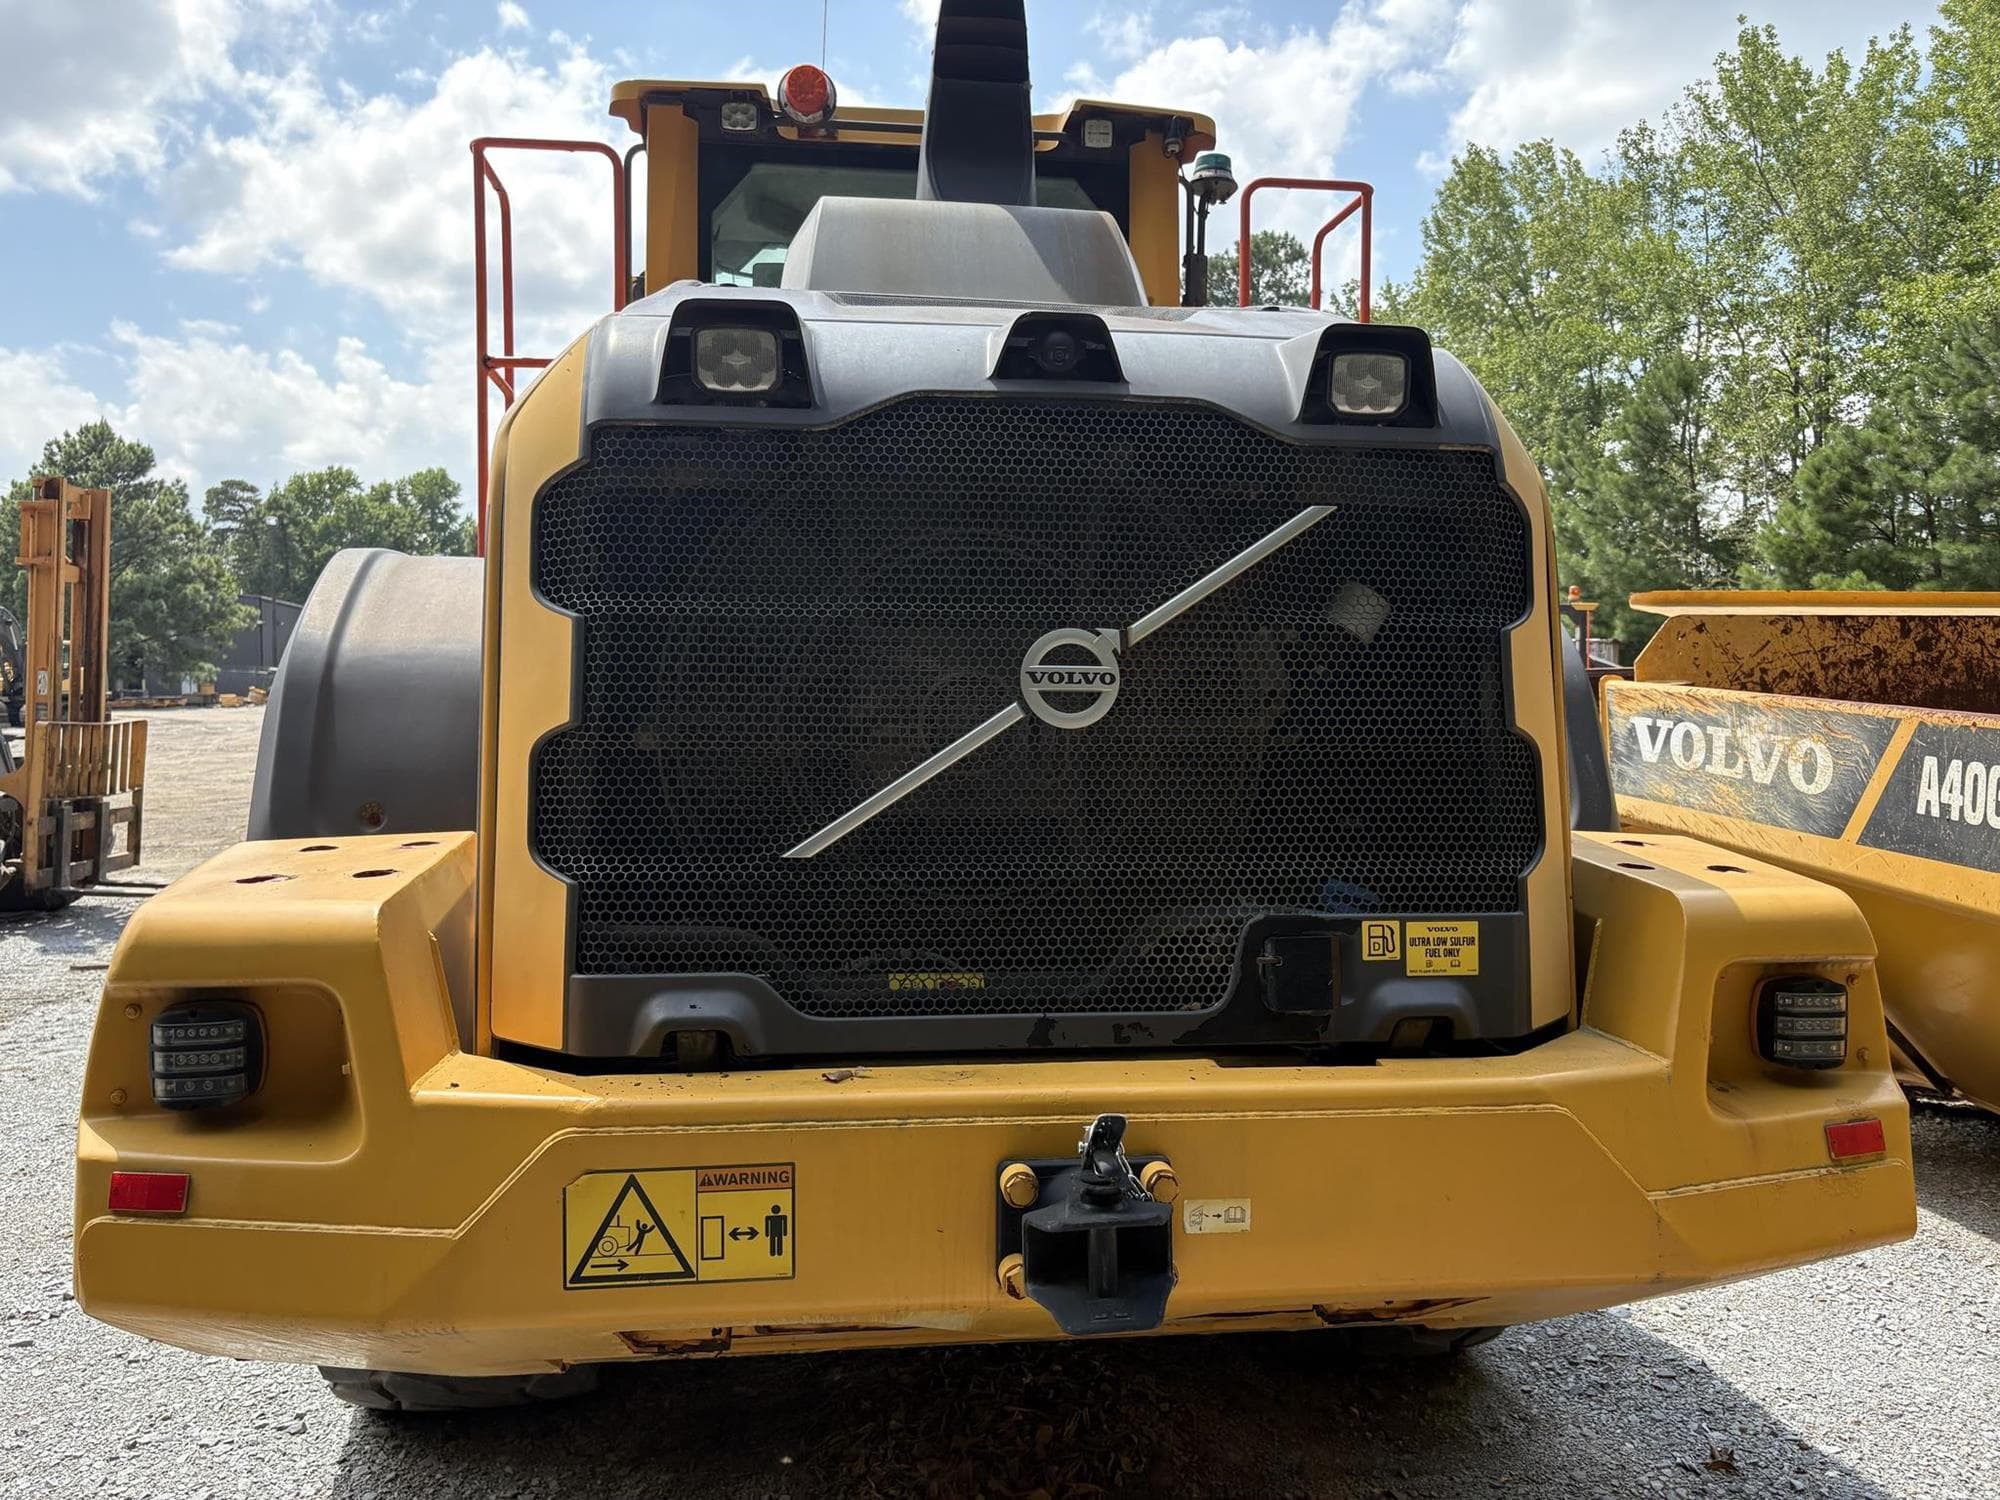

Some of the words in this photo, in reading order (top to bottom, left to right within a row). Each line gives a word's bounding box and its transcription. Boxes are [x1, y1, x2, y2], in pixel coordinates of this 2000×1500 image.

[1025, 671, 1117, 686] VOLVO
[1629, 716, 1835, 796] VOLVO
[1373, 941, 1381, 952] D
[1409, 937, 1431, 947] ULTRA
[1433, 937, 1448, 947] LOW
[1450, 936, 1476, 946] SULFUR
[1425, 948, 1441, 958] FUEL
[1443, 948, 1460, 958] ONLY
[713, 1170, 790, 1186] WARNING
